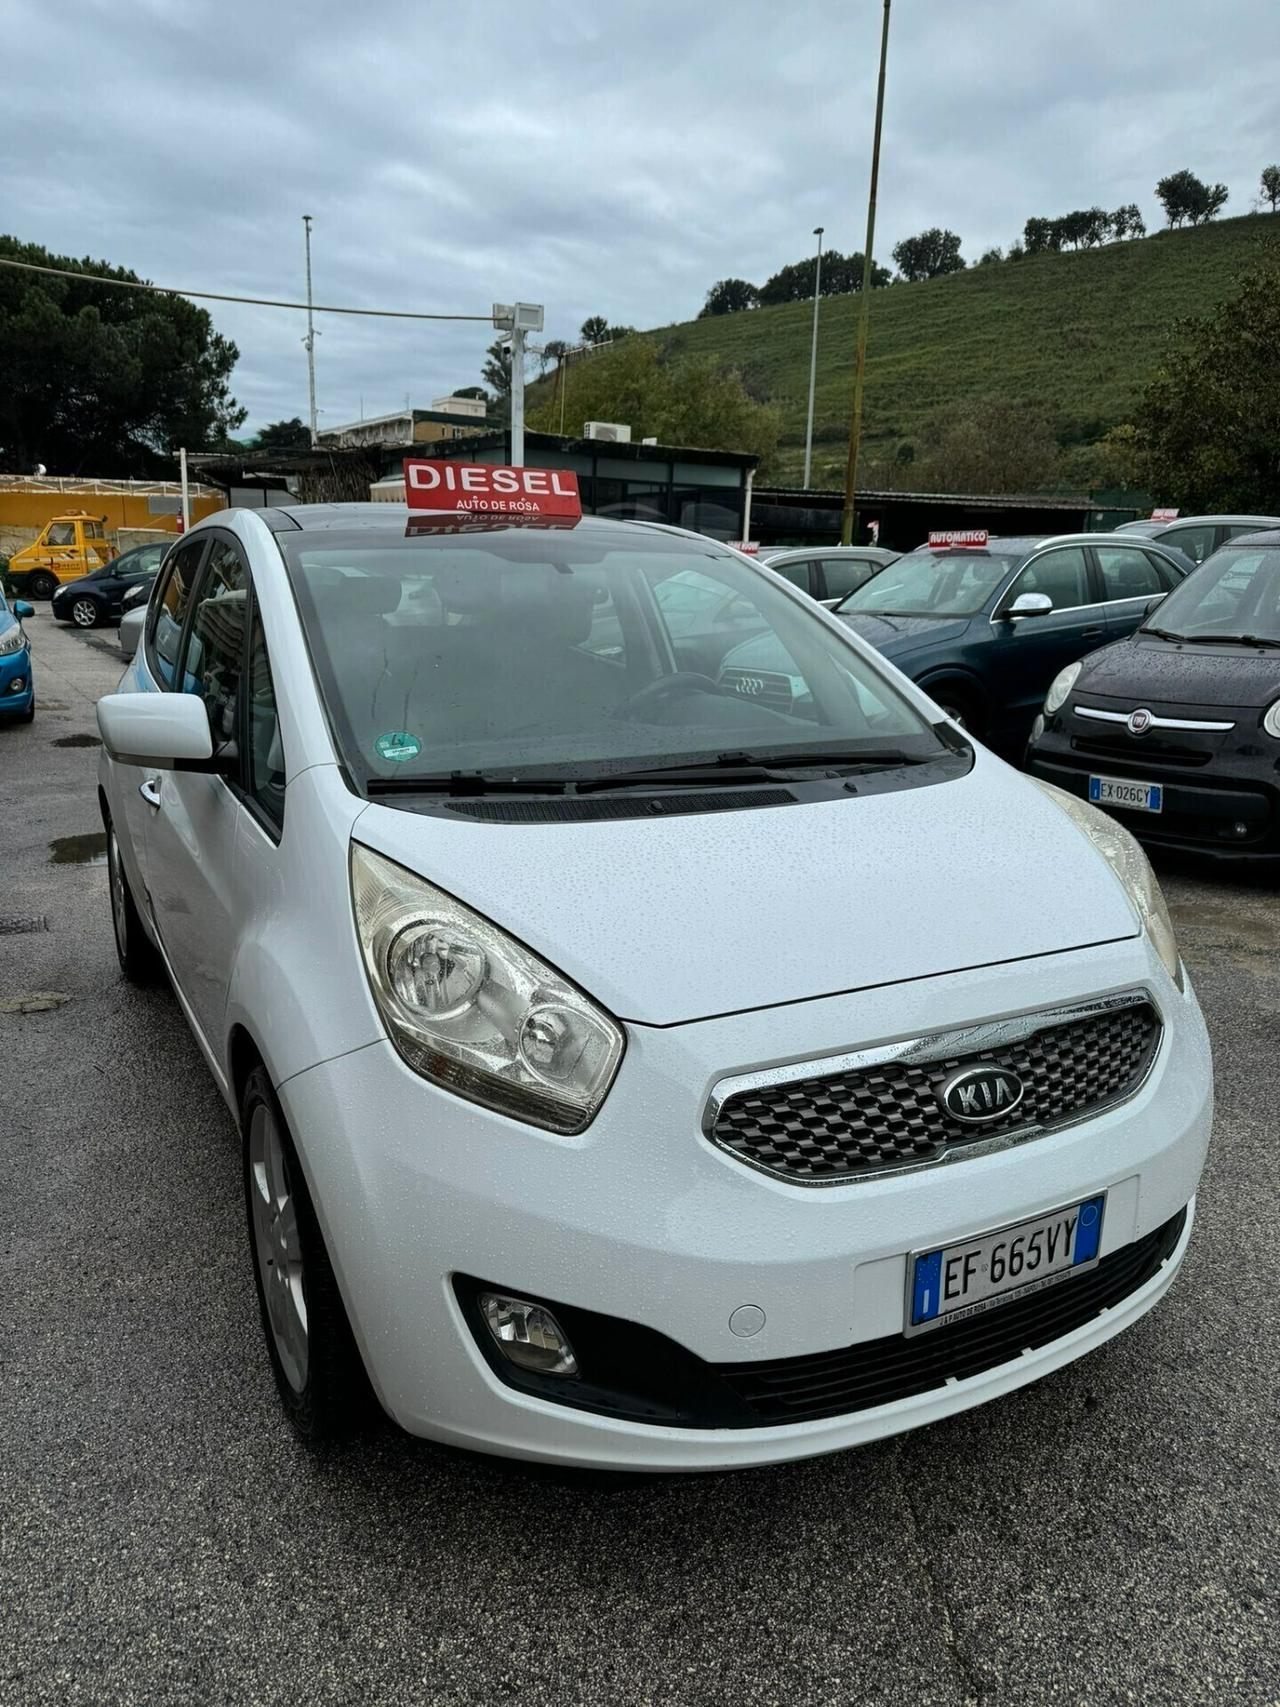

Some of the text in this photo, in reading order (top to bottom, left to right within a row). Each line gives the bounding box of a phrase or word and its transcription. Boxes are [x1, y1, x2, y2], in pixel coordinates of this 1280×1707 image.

[408, 464, 577, 496] DIESEL
[456, 500, 540, 511] AUTO DE ROSA
[930, 531, 986, 543] AUTOMATICO
[957, 1077, 1015, 1114] KIA
[944, 1250, 982, 1300] EF
[990, 1215, 1078, 1284] 665VY
